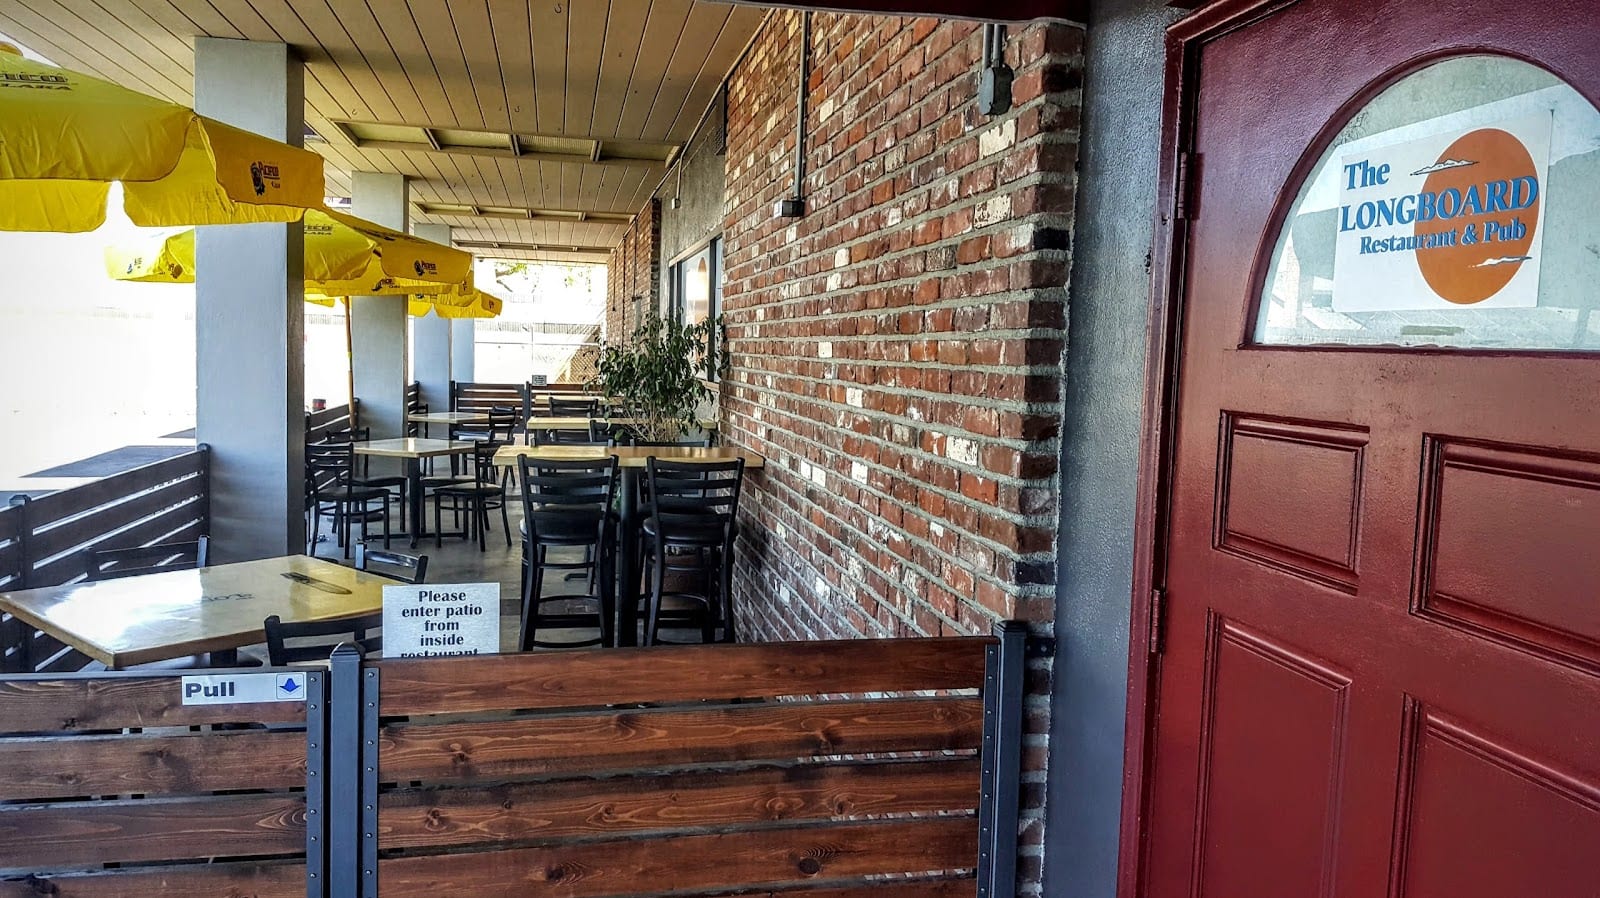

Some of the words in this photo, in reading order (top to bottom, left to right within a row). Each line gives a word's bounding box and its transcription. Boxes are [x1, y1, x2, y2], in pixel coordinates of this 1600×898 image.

[1344, 159, 1390, 190] The
[1340, 175, 1539, 232] LONGBOARD
[1360, 228, 1458, 254] Restaurant
[1461, 223, 1478, 245] &
[1483, 216, 1527, 242] Pub
[418, 590, 467, 602] Please
[401, 606, 441, 617] enter
[446, 604, 483, 618] patio
[424, 620, 459, 631] from
[420, 634, 464, 646] inside
[185, 681, 235, 698] Pull
